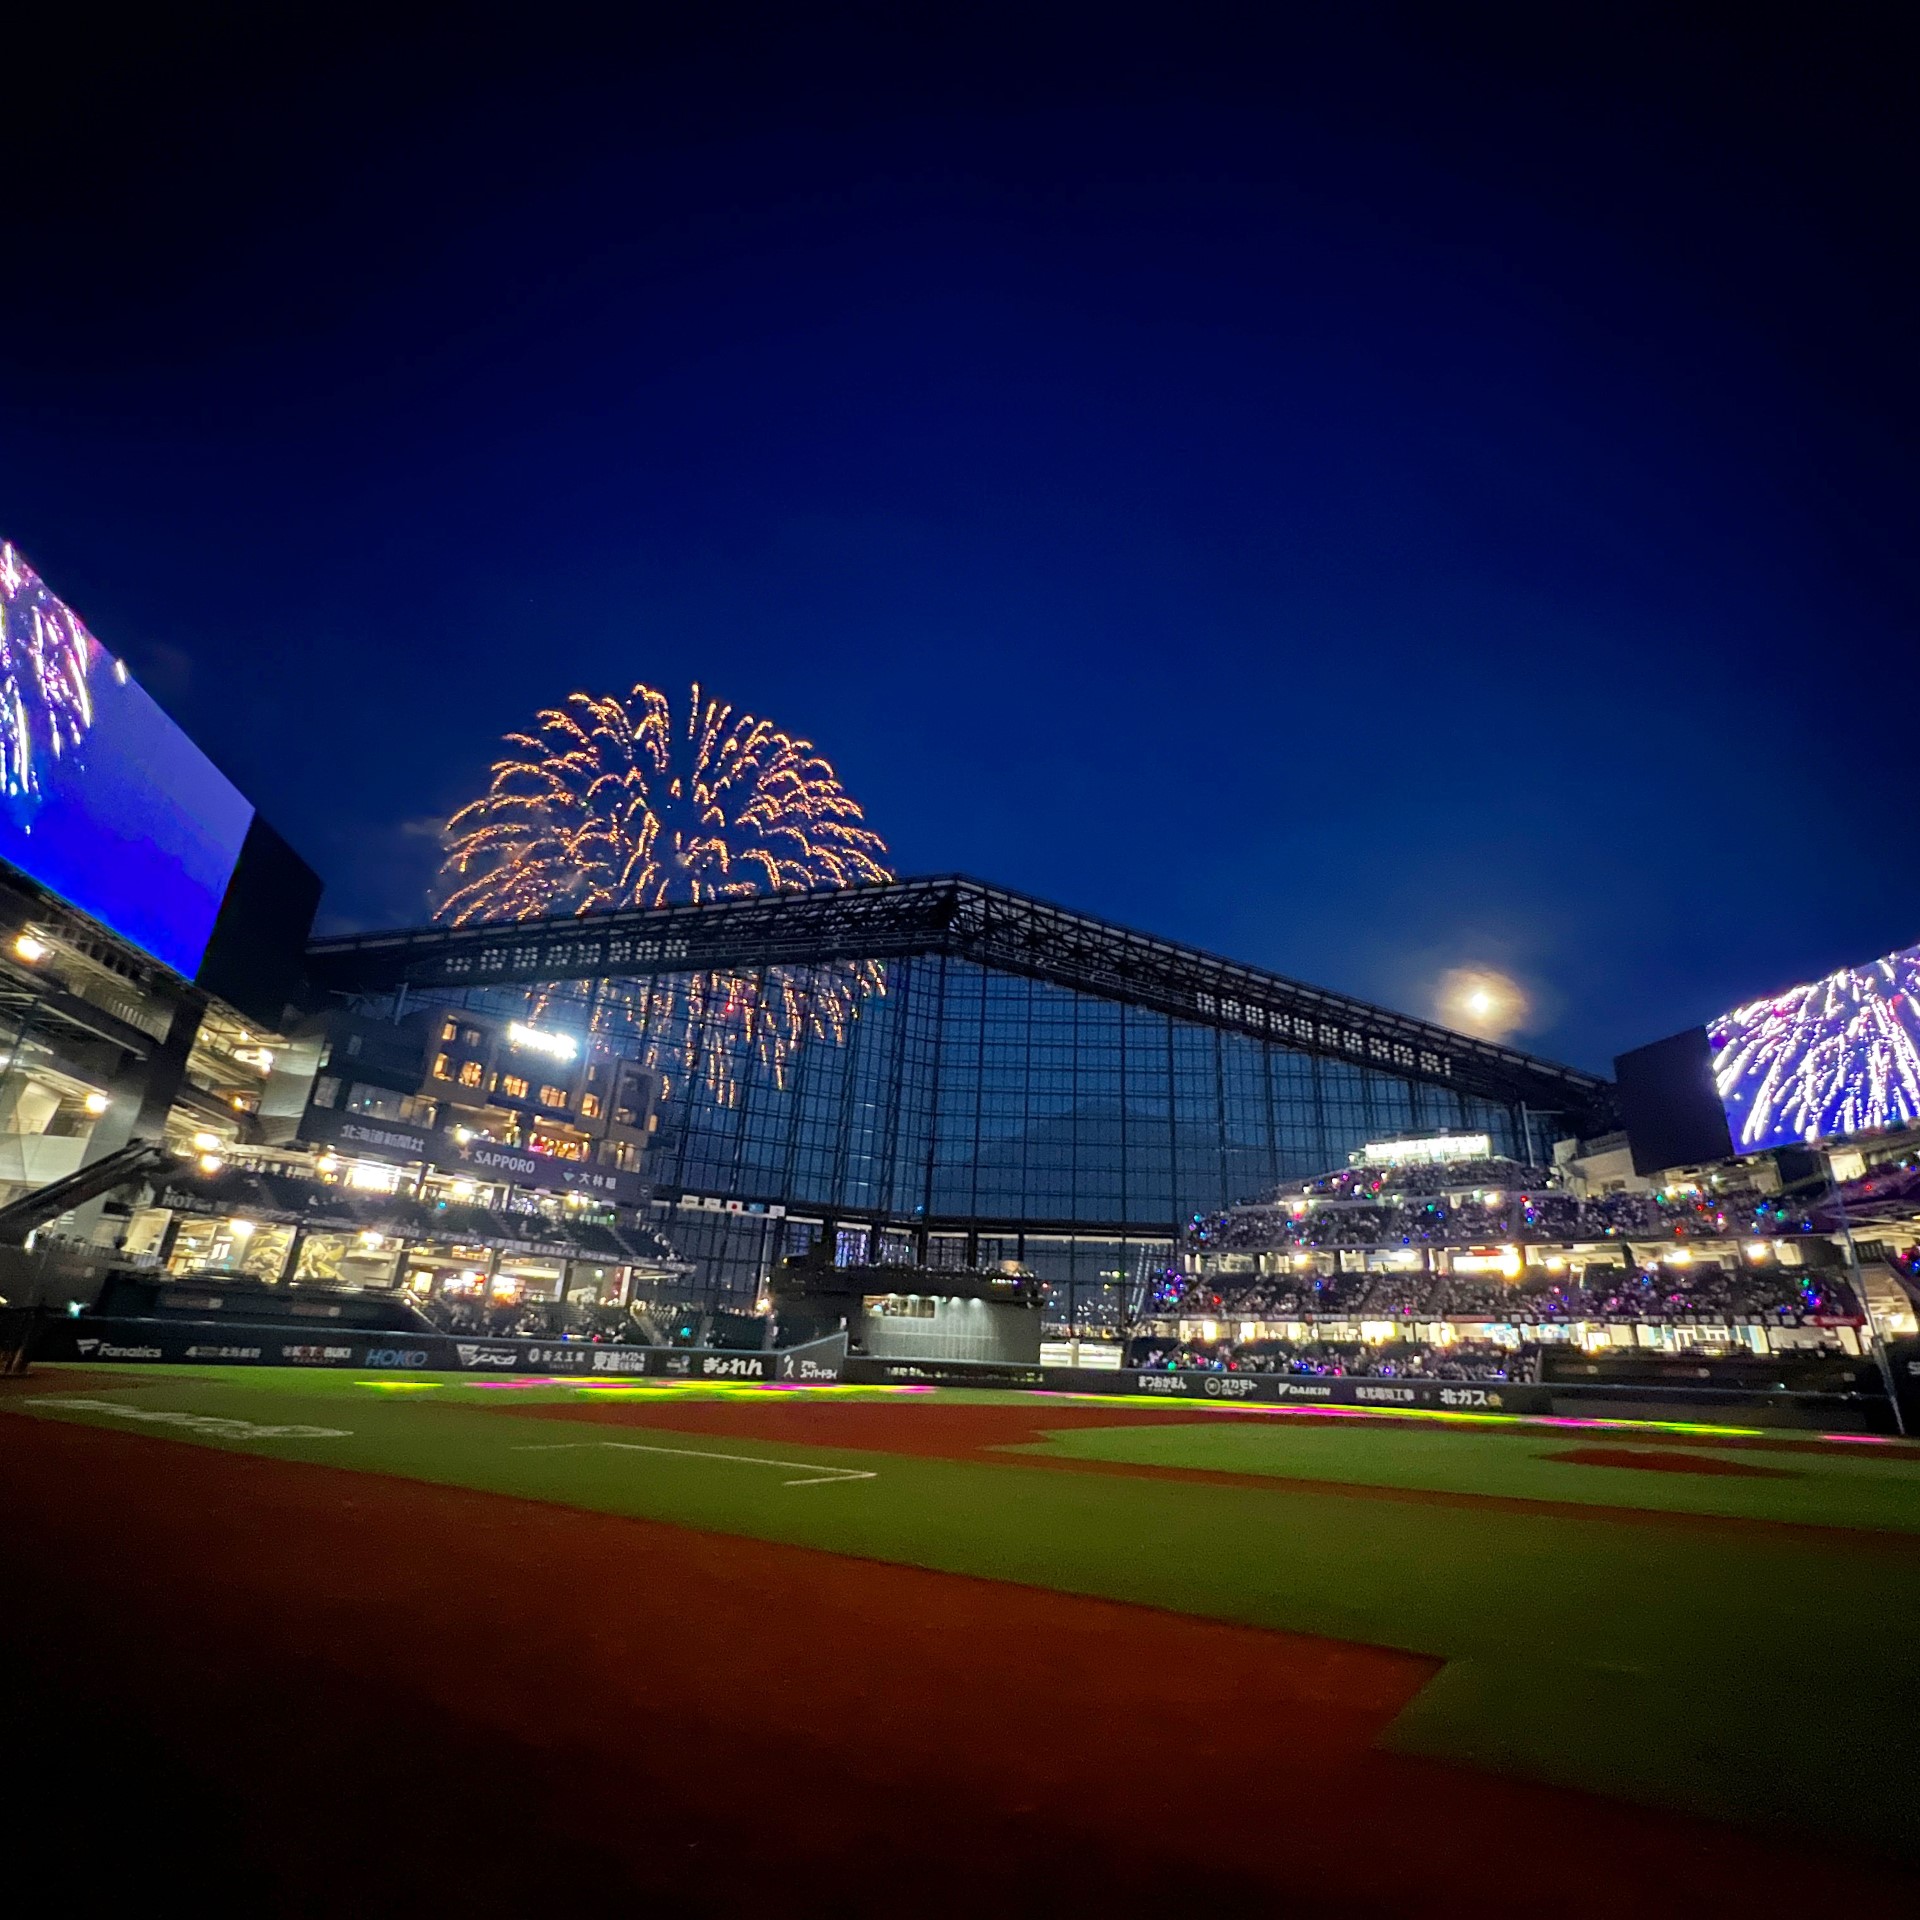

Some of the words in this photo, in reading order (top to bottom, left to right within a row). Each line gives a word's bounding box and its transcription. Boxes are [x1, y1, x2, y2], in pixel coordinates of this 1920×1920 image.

[474, 1150, 535, 1174] SAPPORO
[578, 1172, 617, 1190] 大林組
[97, 1343, 161, 1358] Fanatics
[703, 1357, 763, 1376] ぎょれん
[1221, 1378, 1259, 1390] オカモト
[1289, 1385, 1331, 1396] DAIKIN
[1439, 1388, 1488, 1406] 北ガス
